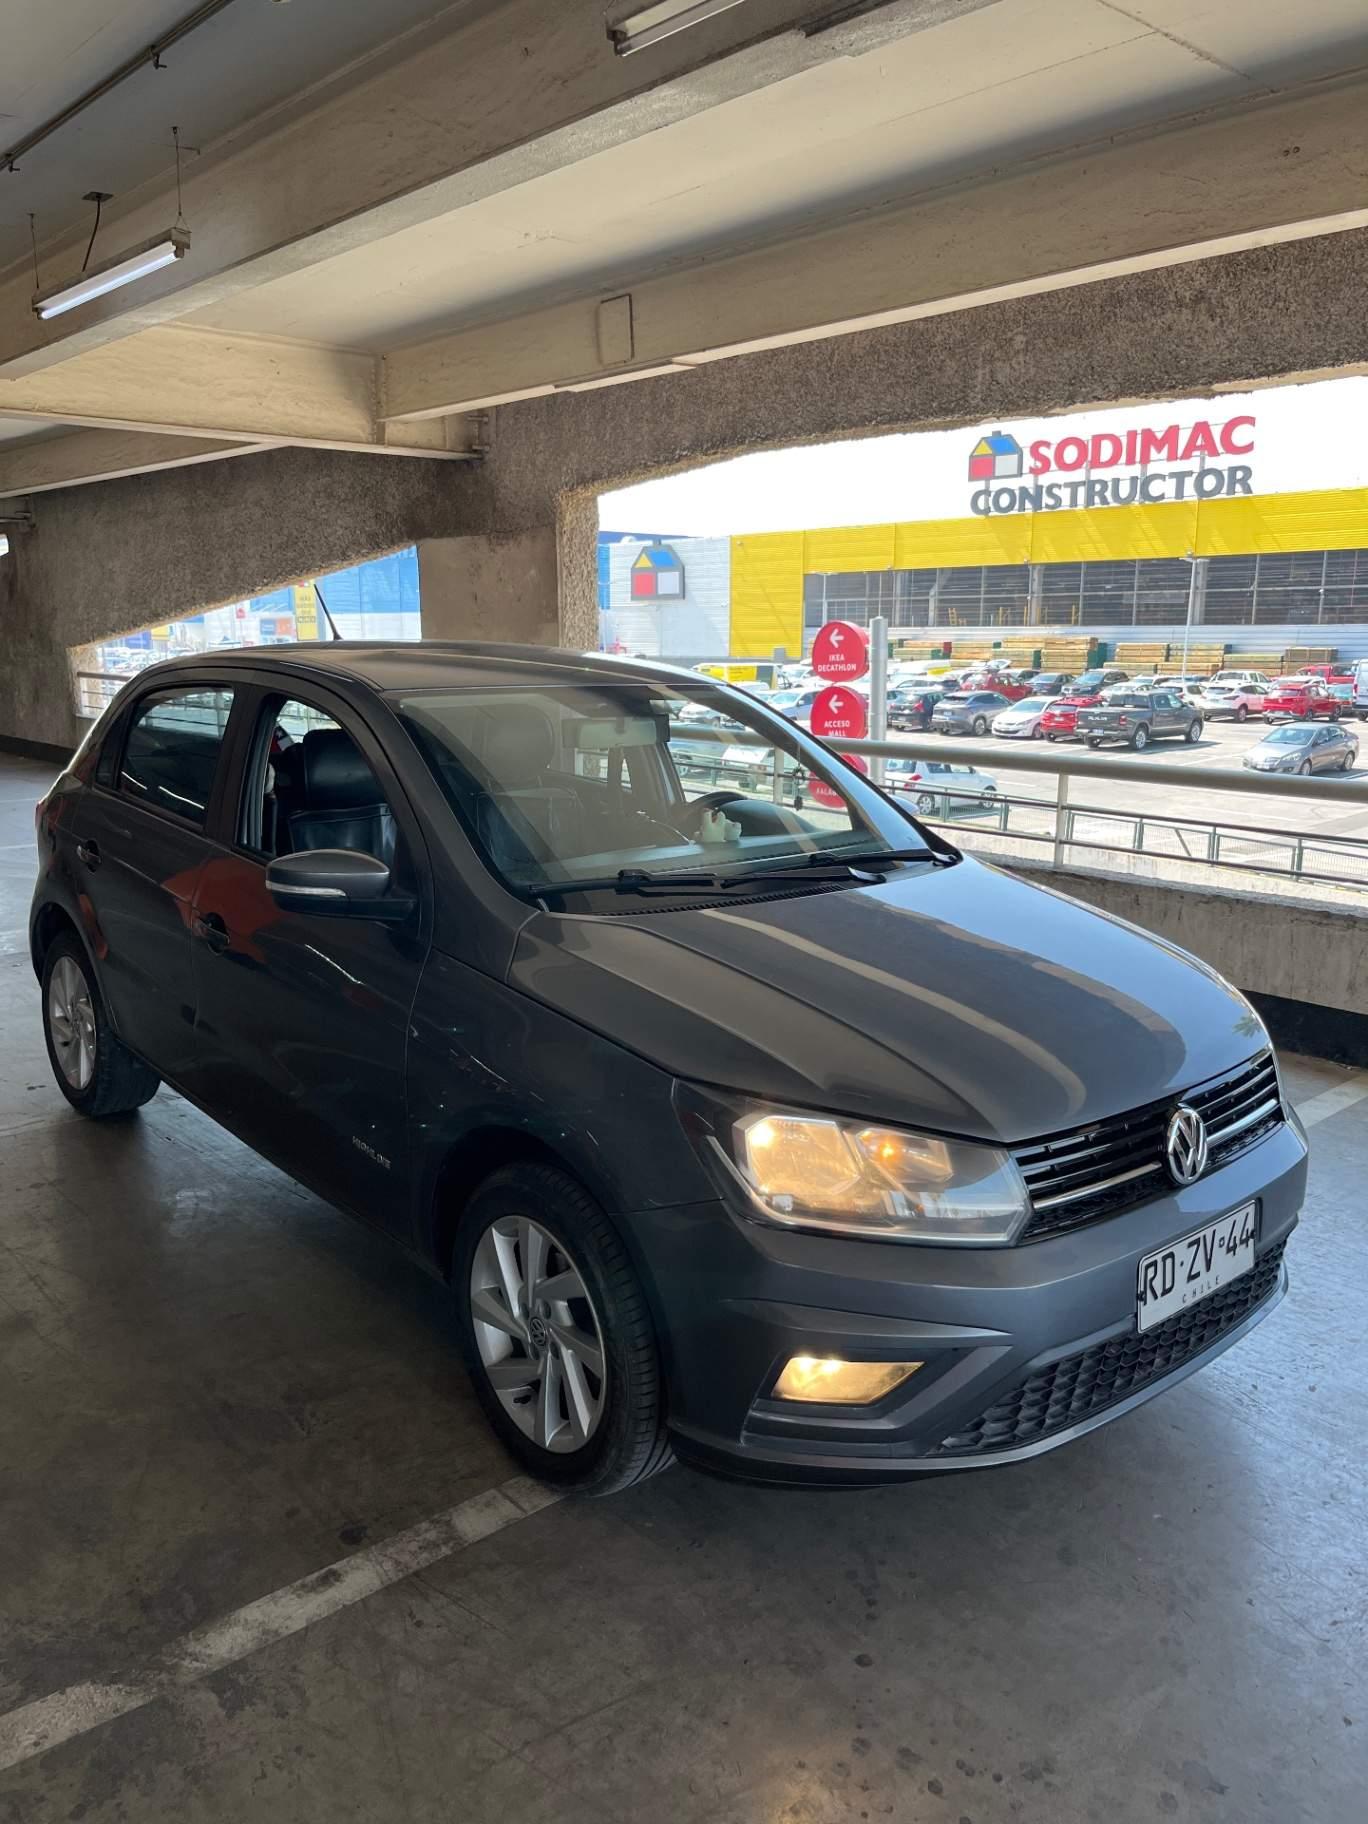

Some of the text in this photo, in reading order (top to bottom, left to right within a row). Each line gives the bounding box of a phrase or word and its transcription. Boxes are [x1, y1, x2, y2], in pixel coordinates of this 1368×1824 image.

[1029, 415, 1256, 475] SODIMAC
[970, 465, 1253, 515] CONSTRUCTOR
[818, 663, 856, 671] DECATHLON
[829, 654, 845, 662] IKEA
[824, 720, 851, 728] ACCESO
[1182, 1275, 1220, 1304] CHILE
